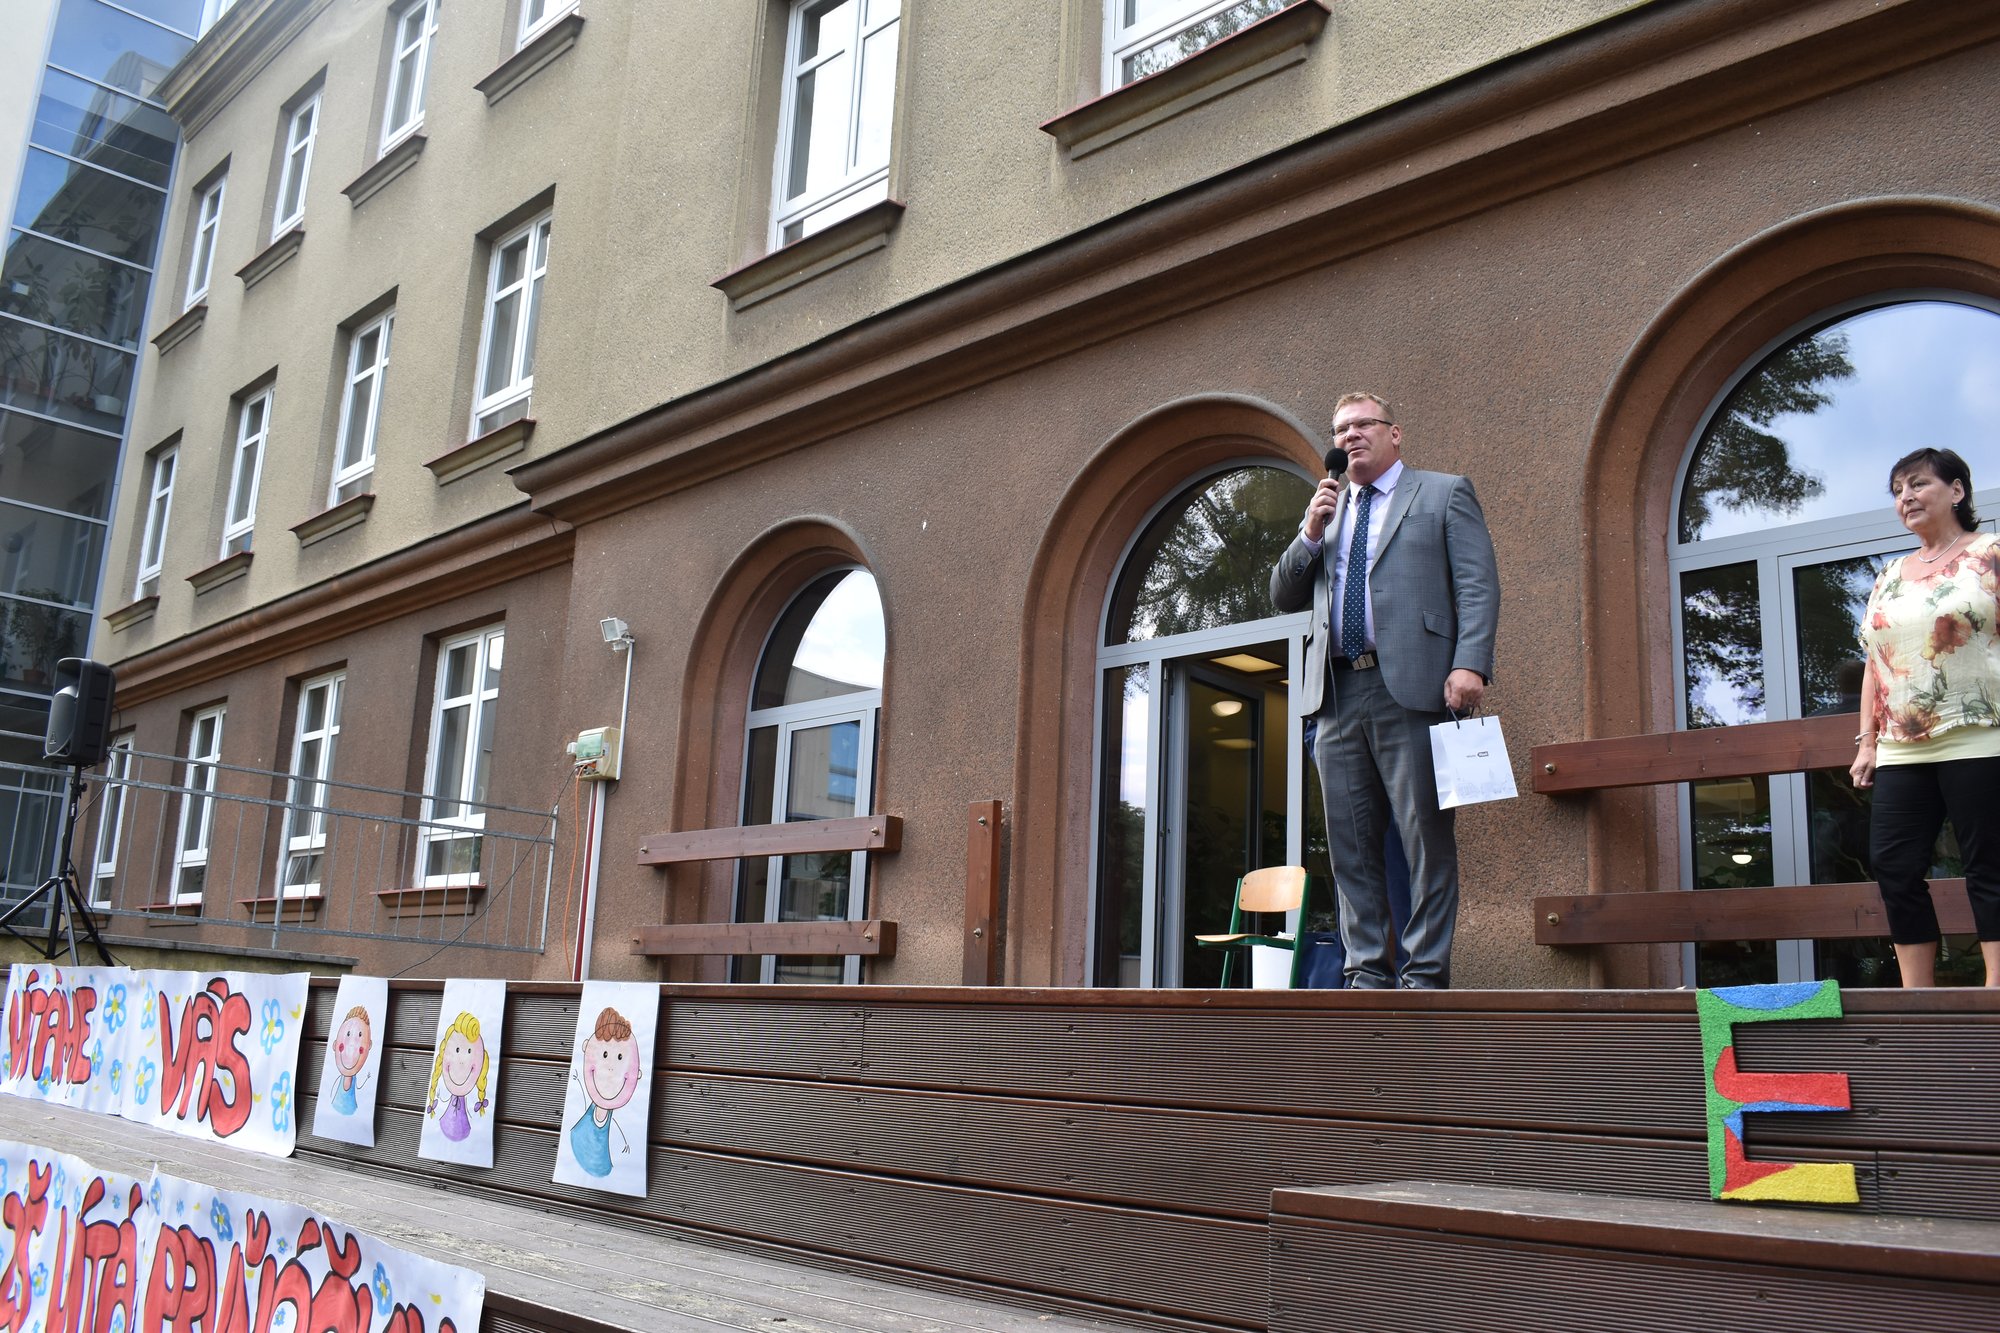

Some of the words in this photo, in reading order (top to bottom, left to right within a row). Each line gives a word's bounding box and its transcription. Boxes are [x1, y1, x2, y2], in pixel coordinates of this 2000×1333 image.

[9, 968, 97, 1086] VÍTÁME
[158, 977, 252, 1138] VÁS
[1696, 979, 1859, 1203] E
[143, 1207, 457, 1333] PRVŇÁČ
